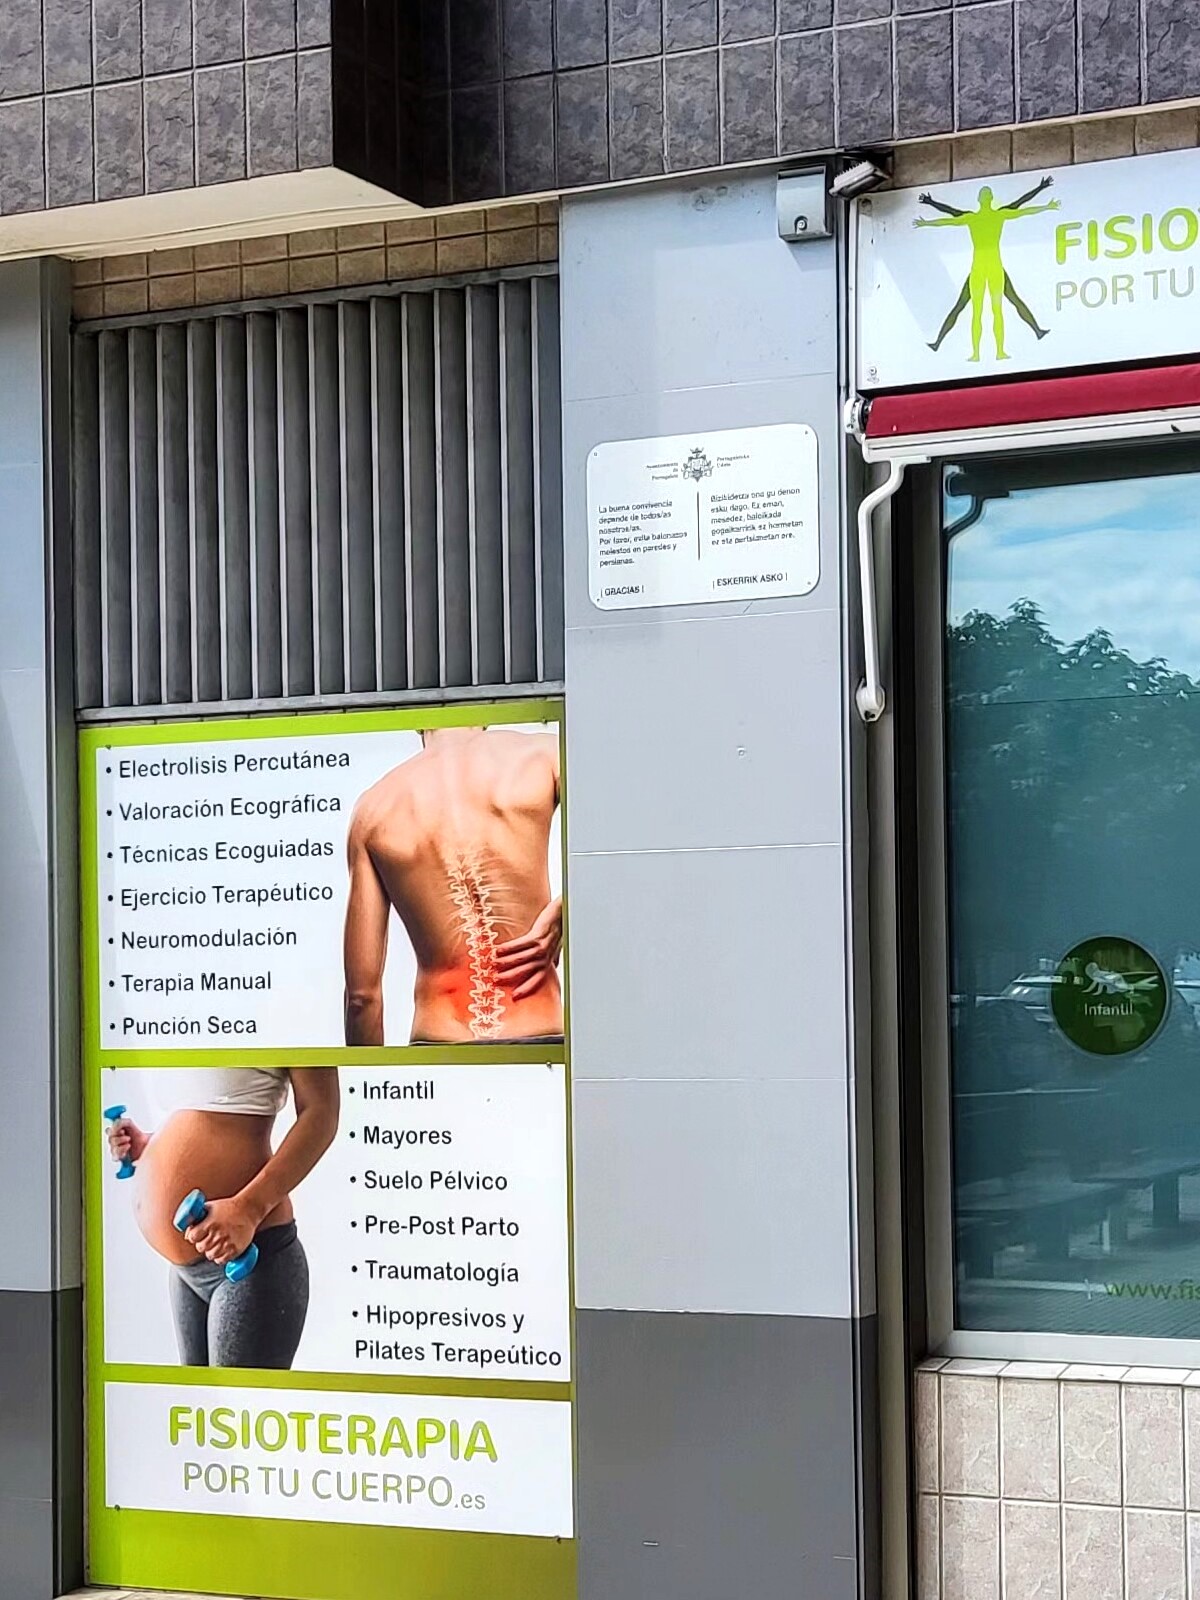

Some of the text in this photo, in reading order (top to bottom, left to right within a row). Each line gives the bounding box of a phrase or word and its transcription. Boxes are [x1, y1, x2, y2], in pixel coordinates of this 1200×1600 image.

[1055, 273, 1135, 313] POR
[1143, 265, 1195, 301] TU
[605, 586, 640, 596] GRACIAS
[760, 573, 784, 583] ASKO
[119, 750, 350, 779] Electrolisis Percutánea
[119, 793, 341, 821] Valoración Ecográfica
[119, 838, 334, 864] Técnicas Ecoguiadas
[121, 882, 333, 912] Ejercicio Terapéutico
[121, 926, 297, 950] Neuromodulación
[121, 971, 271, 997] Terapia Manual
[1084, 1001, 1134, 1016] Infantil
[123, 1015, 257, 1036] Punción Seca
[363, 1080, 434, 1100] Infantil
[363, 1125, 452, 1150] Mayores
[364, 1169, 508, 1191] Suelo Pélvico
[365, 1214, 520, 1237] Pre-Post Parto
[364, 1259, 519, 1287] Traumatología
[366, 1304, 525, 1334] Hipopresivos y
[355, 1339, 562, 1369] Pilates Terapeútico
[169, 1405, 498, 1462] FISIOTERAPIA
[183, 1462, 486, 1511] POR TU CUERPO.es
